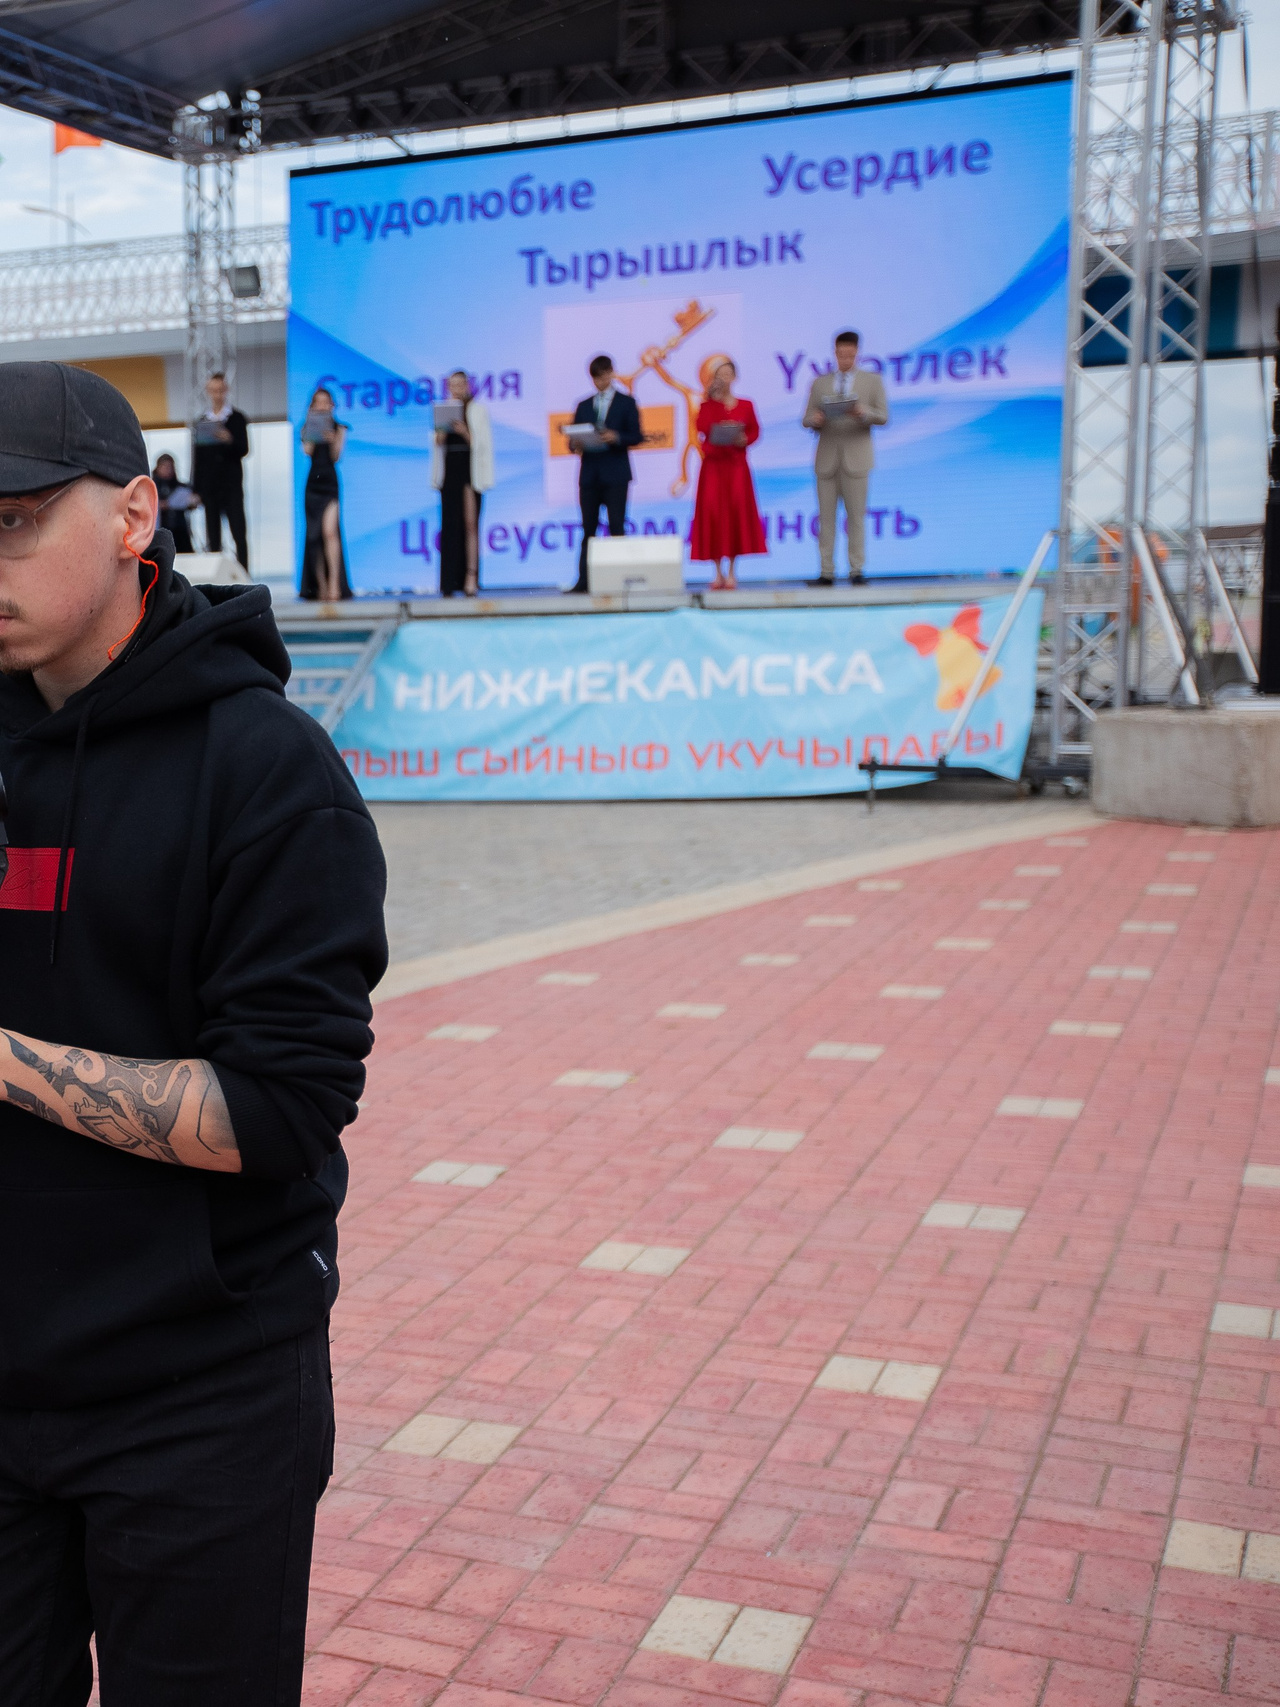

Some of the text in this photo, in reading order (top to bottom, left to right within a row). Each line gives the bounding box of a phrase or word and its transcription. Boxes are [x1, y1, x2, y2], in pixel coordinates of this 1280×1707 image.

[763, 138, 993, 197] Усердие
[309, 173, 595, 243] Трудолюбие
[521, 230, 805, 290] Тырышлык
[394, 650, 885, 711] НИЖНЕКАМСКА
[455, 735, 671, 776] СЫЙНЫФ
